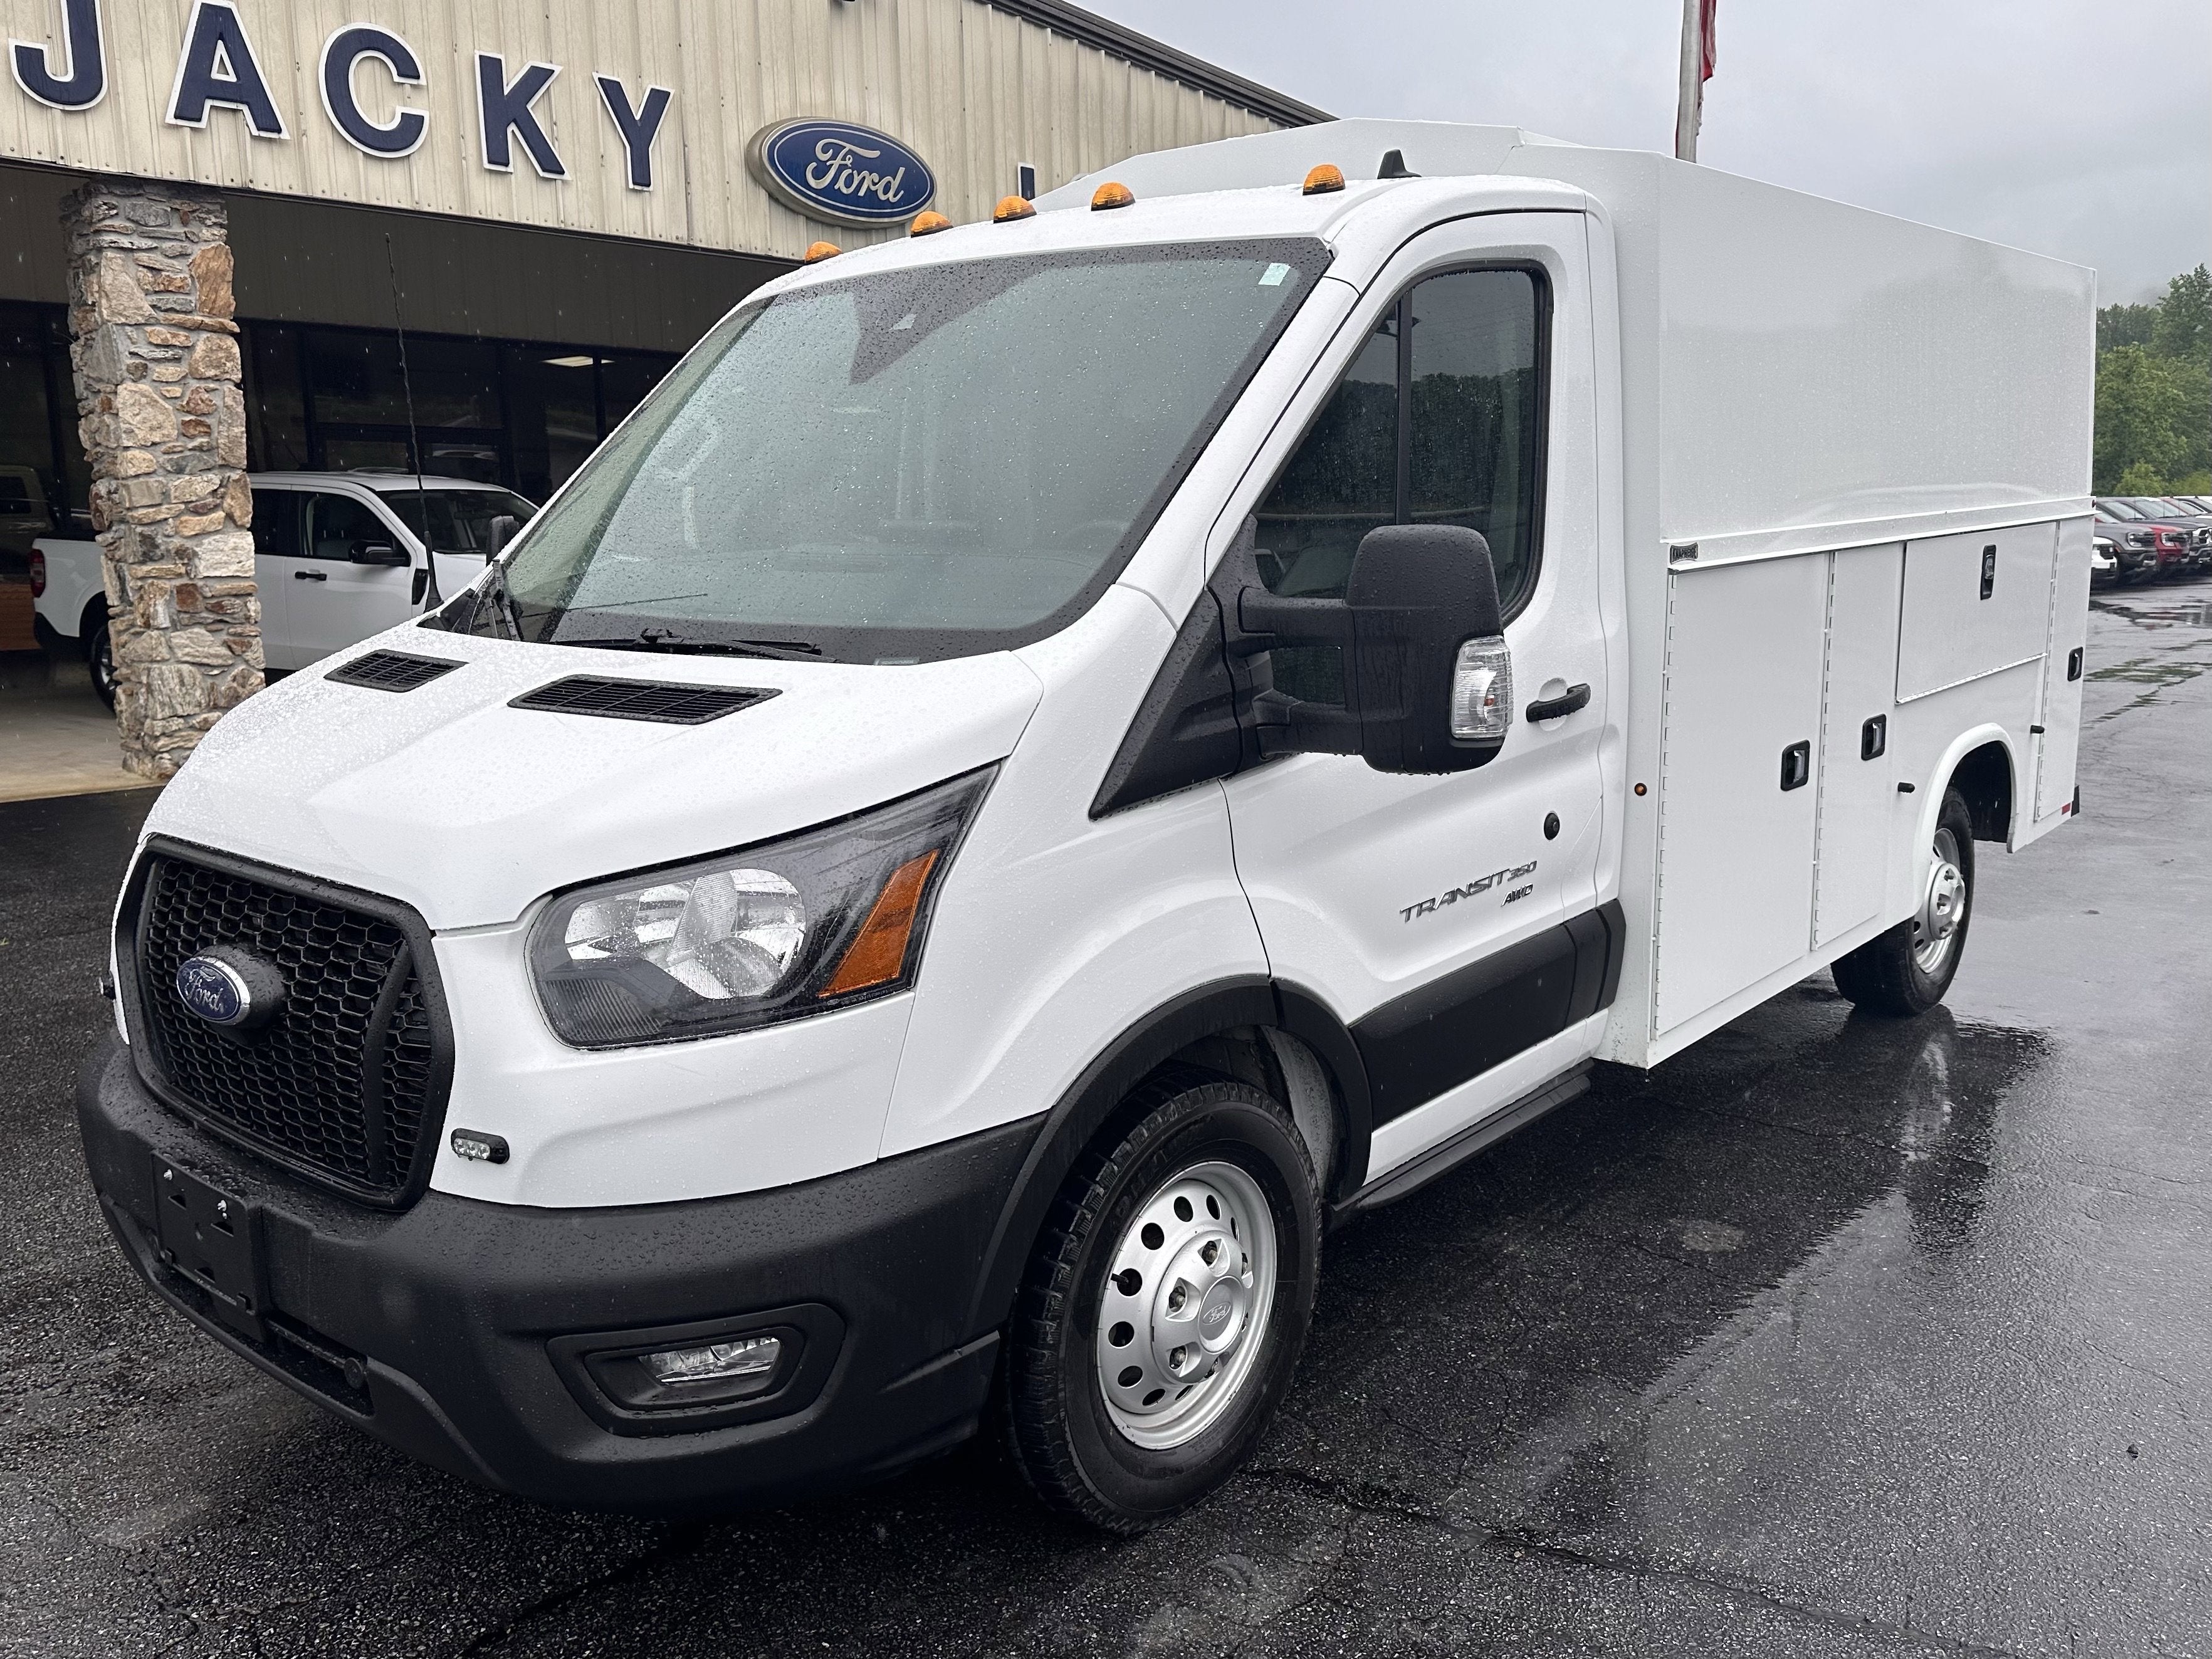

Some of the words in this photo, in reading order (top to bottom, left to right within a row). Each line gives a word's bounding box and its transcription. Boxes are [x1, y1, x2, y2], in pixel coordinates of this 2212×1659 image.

[9, 0, 674, 191] JACKY
[805, 138, 906, 204] Ford
[1399, 868, 1510, 924] TRANSIT
[1507, 860, 1538, 882] 350
[1501, 882, 1533, 908] AWD
[184, 966, 224, 1013] Ford
